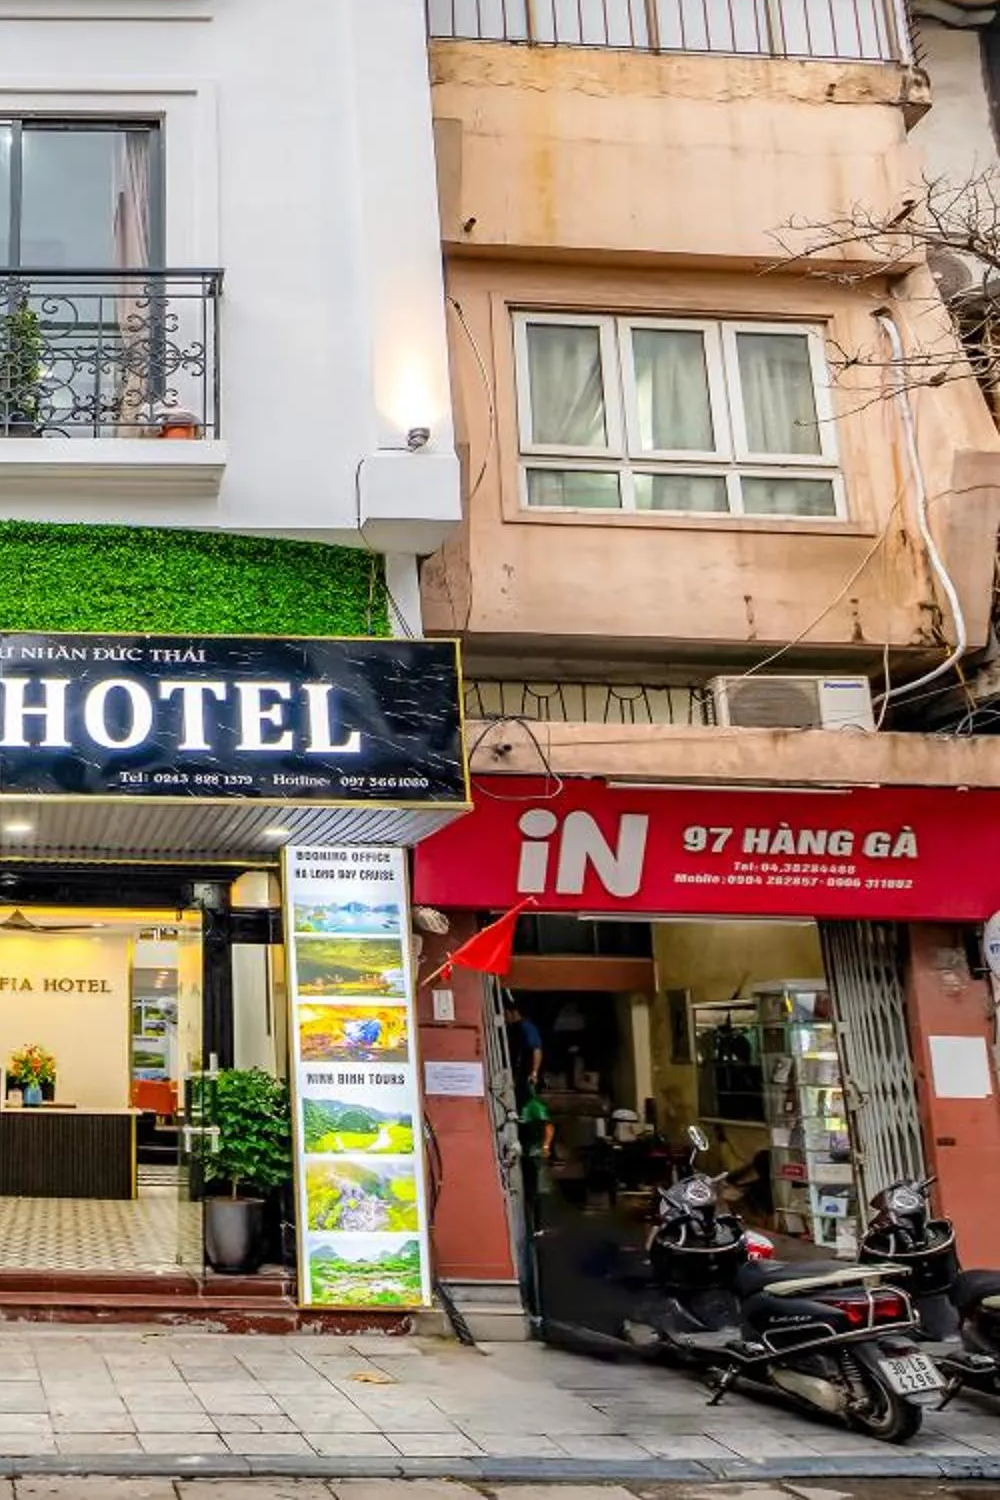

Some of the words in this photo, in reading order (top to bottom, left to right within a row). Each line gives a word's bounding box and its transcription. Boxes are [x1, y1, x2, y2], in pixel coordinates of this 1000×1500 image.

[684, 826, 733, 853] 97
[743, 822, 854, 857] HÀNG
[863, 826, 918, 858] GÀ
[43, 978, 112, 993] HOTEL
